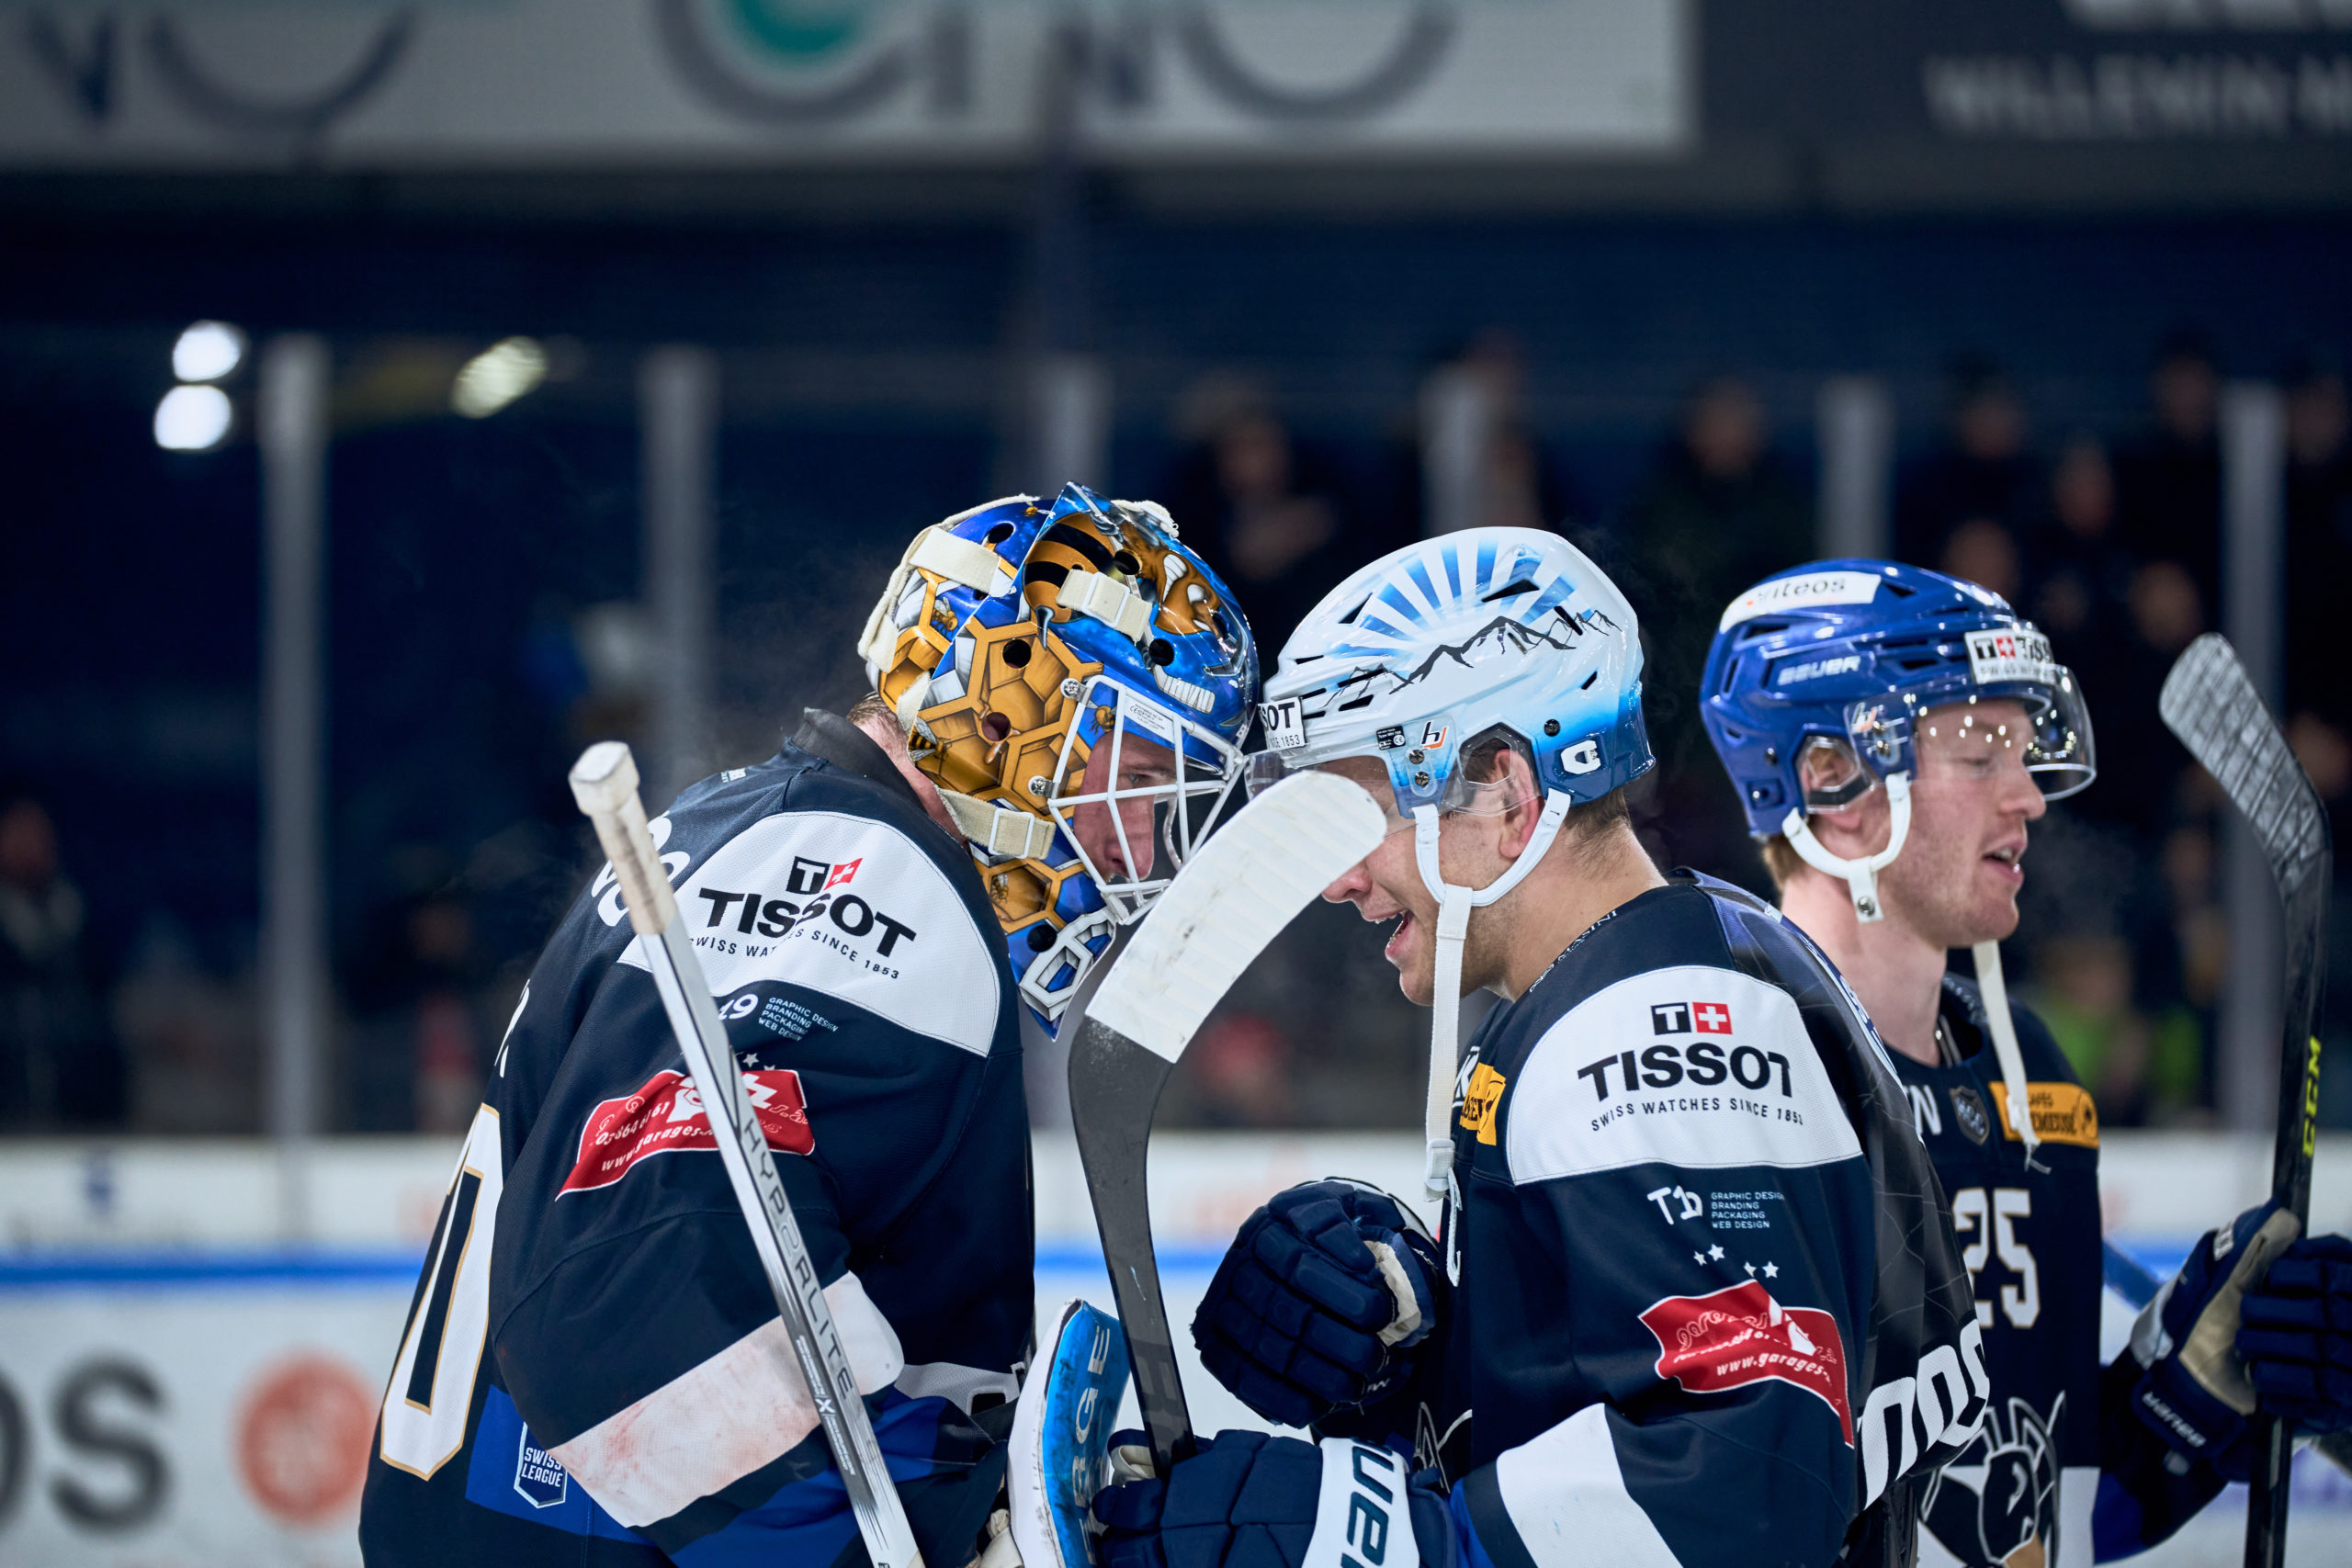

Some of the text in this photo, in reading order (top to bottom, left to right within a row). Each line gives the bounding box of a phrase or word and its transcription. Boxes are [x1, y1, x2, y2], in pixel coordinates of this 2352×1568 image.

[1778, 655, 1861, 686] BAUER
[698, 887, 917, 958] TISSOT
[811, 931, 859, 963] SINCE
[865, 960, 899, 980] 1853
[758, 1017, 777, 1031] WEB
[764, 1003, 812, 1028] BRANDING
[768, 997, 839, 1033] GRAPHIC DESIGN
[1577, 1042, 1792, 1102] TISSOT
[2302, 1034, 2322, 1158] CCM
[1591, 1102, 1634, 1132] SWISS
[1642, 1098, 1720, 1114] WATCHES
[1730, 1099, 1768, 1118] SINCE
[1711, 1191, 1752, 1201] GRAPHIC
[1711, 1201, 1759, 1210] BRANDING
[1711, 1211, 1766, 1220] PACKAGING
[1712, 1220, 1770, 1229] WEB DESIGN
[1953, 1189, 2041, 1330] 25
[524, 1447, 562, 1471] SWISS
[521, 1462, 564, 1488] LEAGUE
